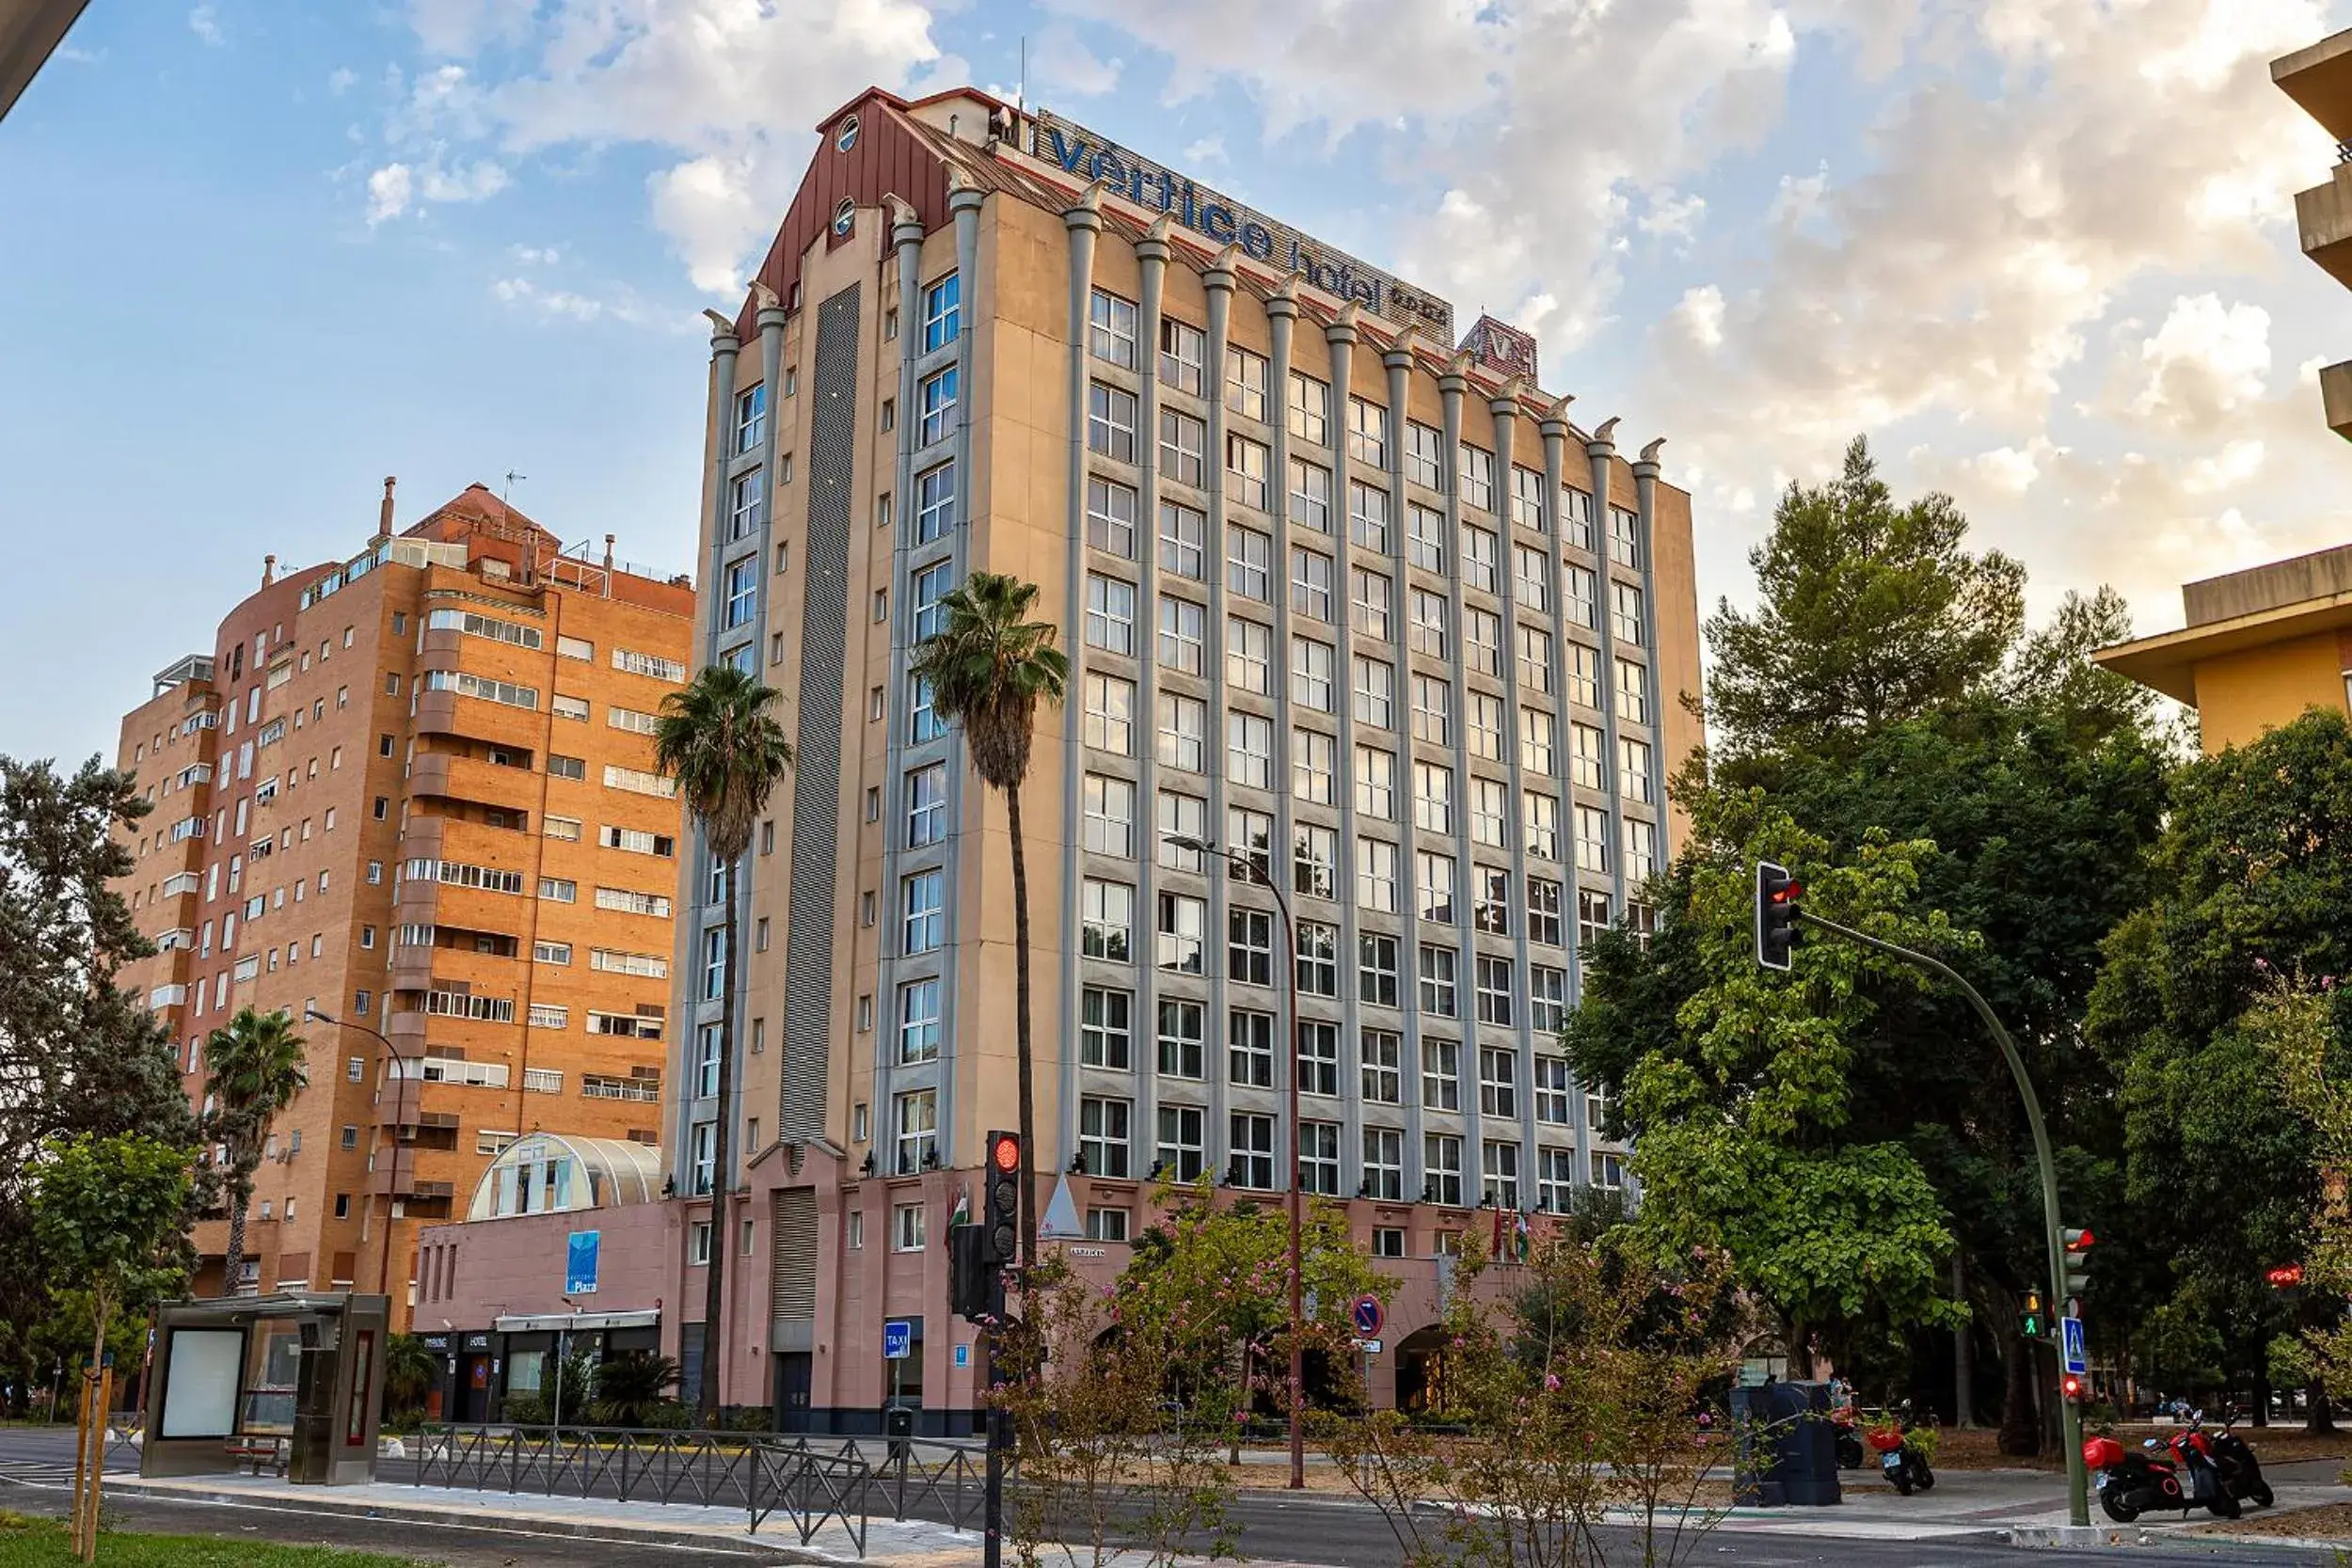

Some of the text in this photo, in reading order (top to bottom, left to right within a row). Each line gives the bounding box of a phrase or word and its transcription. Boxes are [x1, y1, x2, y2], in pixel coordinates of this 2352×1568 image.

[1290, 241, 1381, 315] hotel
[469, 1336, 487, 1347] HOTEL
[887, 1335, 907, 1346] TAXI
